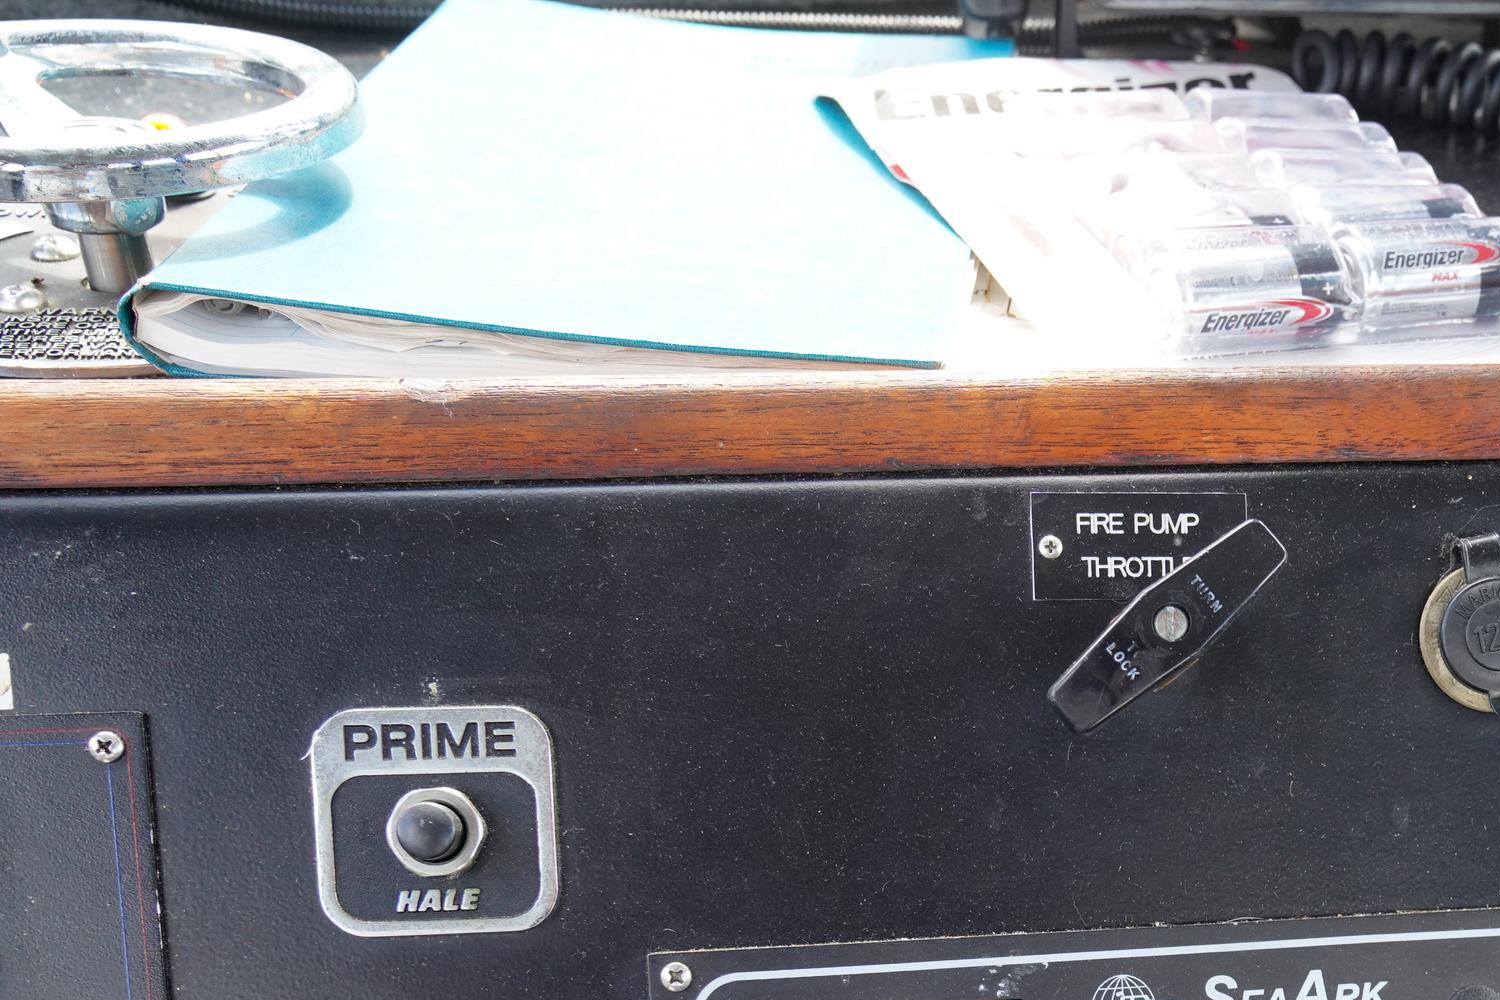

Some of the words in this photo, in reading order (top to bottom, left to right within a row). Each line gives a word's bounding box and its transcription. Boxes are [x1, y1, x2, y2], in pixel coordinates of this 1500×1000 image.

[1384, 247, 1464, 270] Energizer
[1200, 307, 1291, 334] Energizer
[1075, 512, 1125, 535] FIRE
[1133, 512, 1200, 535] PUMP
[1080, 556, 1196, 578] THROTTL
[1190, 574, 1223, 614] TURN
[1105, 641, 1141, 681] LOCK
[342, 719, 519, 762] PRIME
[396, 887, 481, 914] HALE
